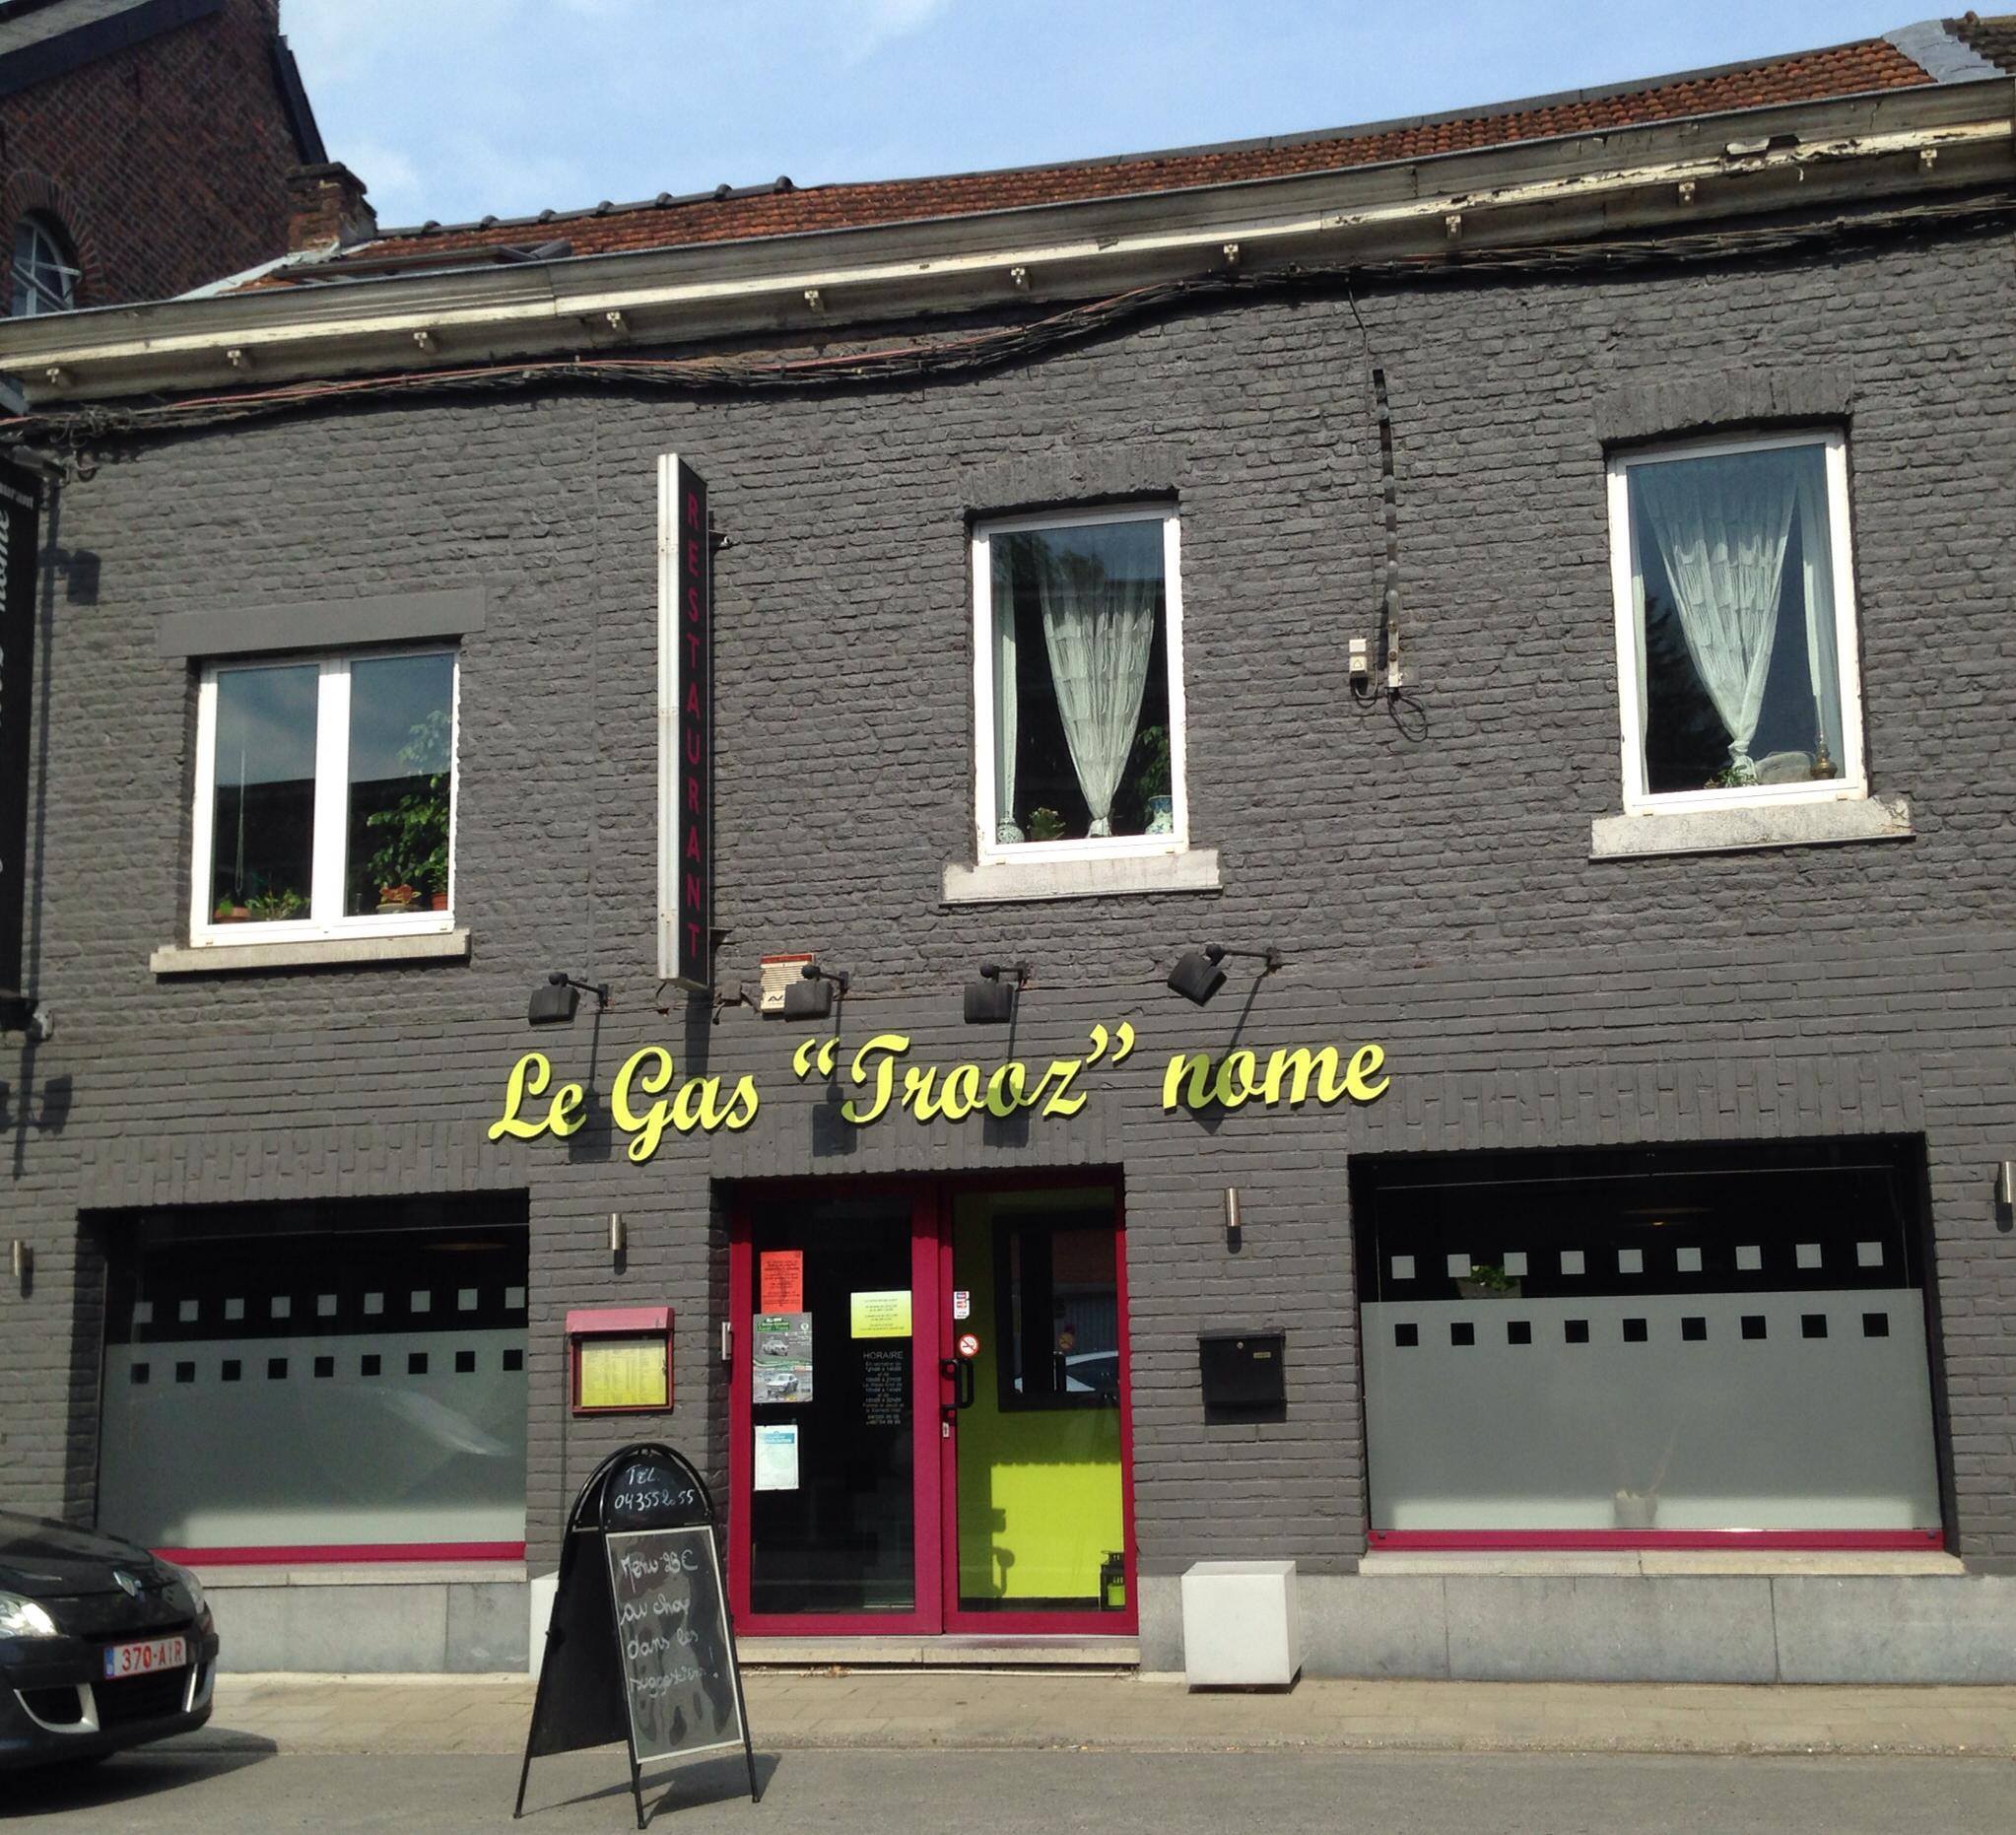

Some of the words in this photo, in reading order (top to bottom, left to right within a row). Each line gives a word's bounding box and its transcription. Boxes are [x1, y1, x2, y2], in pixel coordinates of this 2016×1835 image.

[686, 493, 701, 960] RESTAURANT
[488, 1052, 587, 1141] Le
[611, 1046, 759, 1162] Gas
[1162, 1044, 1391, 1110] nome
[862, 1350, 904, 1360] HORAIRE
